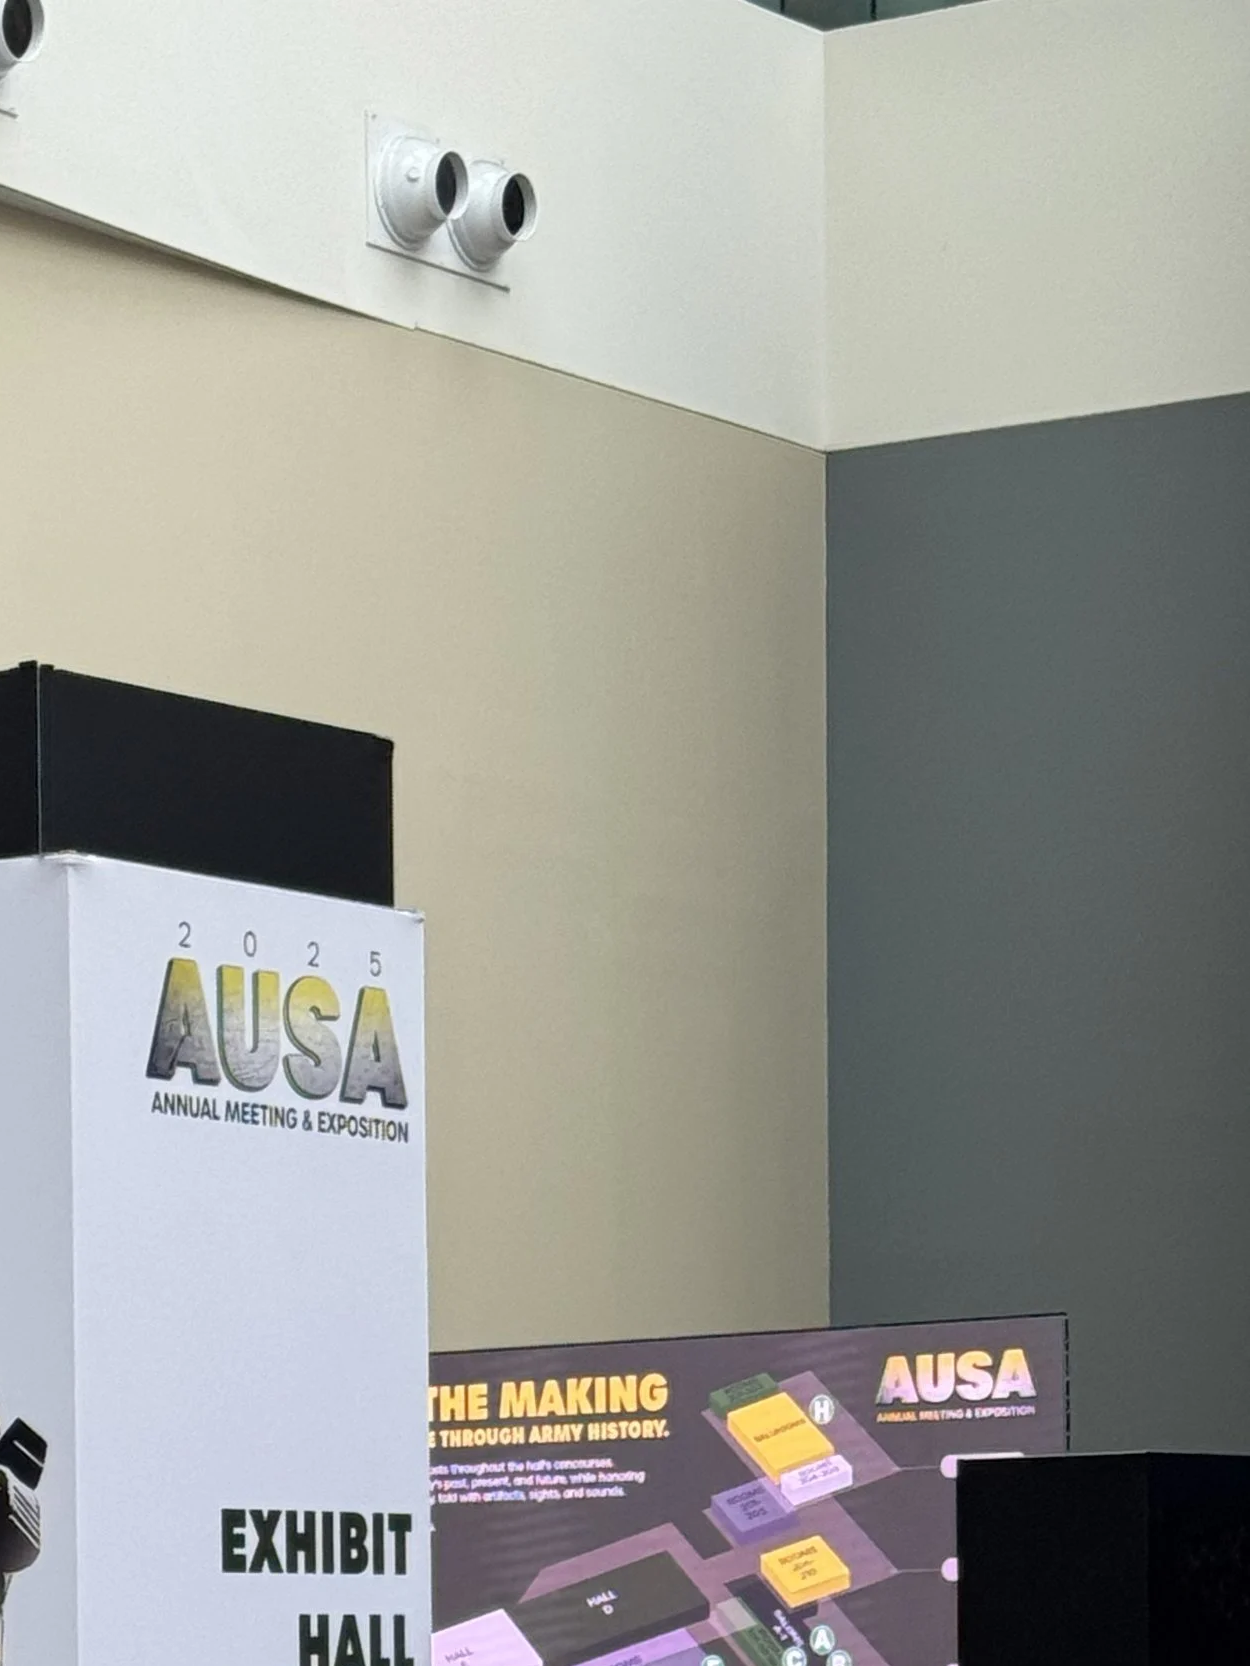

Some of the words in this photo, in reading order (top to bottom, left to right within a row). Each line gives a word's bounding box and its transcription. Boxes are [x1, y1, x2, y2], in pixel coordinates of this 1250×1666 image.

[145, 957, 408, 1111] AUSA
[151, 1091, 220, 1121] ANNUAL
[225, 1100, 297, 1130] MEETING
[302, 1111, 313, 1132] &
[317, 1111, 409, 1143] EXPOSITION
[499, 1373, 669, 1419] MAKING
[875, 1348, 1037, 1405] AUSA
[440, 1425, 525, 1449] THROUGH
[528, 1423, 584, 1444] ARMY
[588, 1418, 670, 1442] HISTORY.
[814, 1400, 831, 1422] H
[221, 1508, 412, 1575] EXHIBIT
